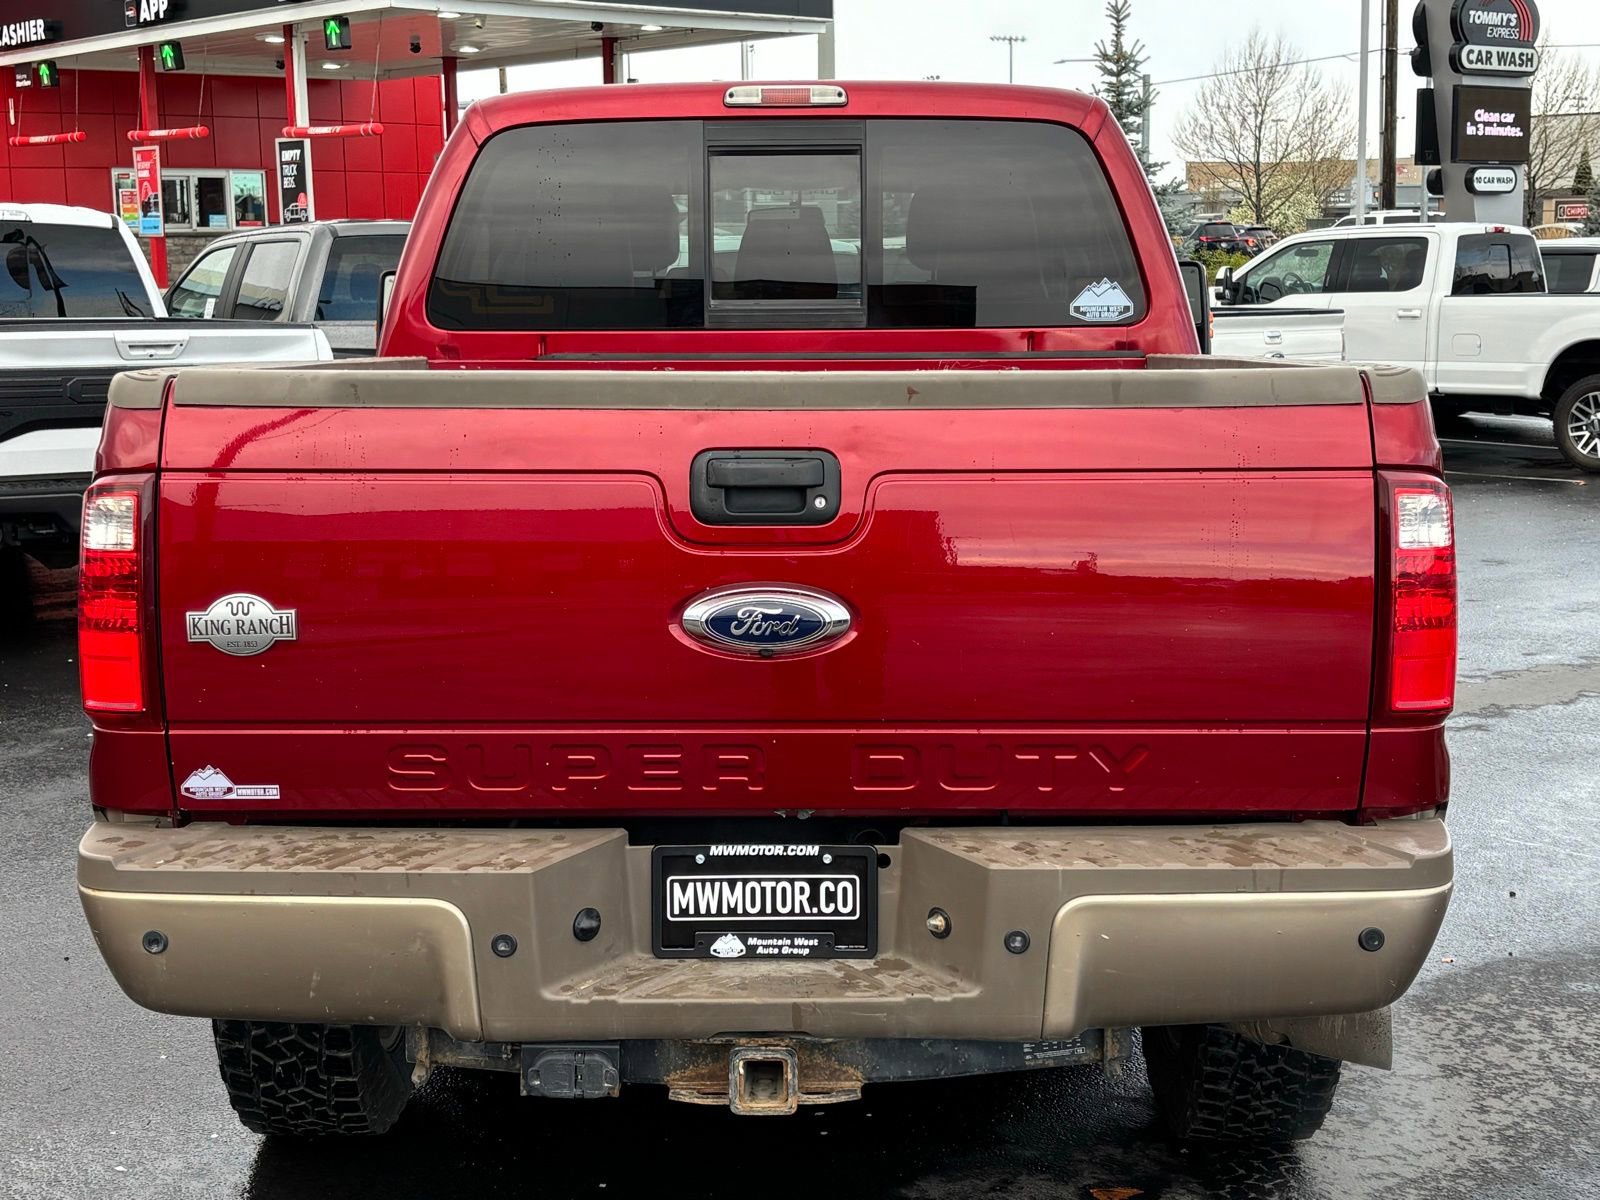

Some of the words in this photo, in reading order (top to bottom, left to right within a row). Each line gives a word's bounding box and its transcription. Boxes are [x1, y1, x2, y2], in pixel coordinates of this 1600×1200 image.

[139, 0, 168, 22] APP
[1469, 10, 1517, 26] TOMMY'S
[1487, 26, 1519, 39] EXPRESS
[1466, 49, 1493, 65] CAR
[1497, 50, 1534, 68] WASH
[1474, 109, 1500, 122] Clean
[1500, 113, 1516, 123] car
[1466, 122, 1476, 135] in
[1477, 123, 1484, 136] 3
[1484, 123, 1523, 137] minutes.
[281, 149, 301, 162] EMPTY
[282, 164, 298, 176] TRUCK
[1483, 176, 1495, 184] CAR
[1496, 176, 1514, 185] WASH
[191, 617, 231, 636] KING
[235, 615, 292, 635] RANCH
[730, 606, 801, 636] Ford
[386, 743, 767, 792] SUPER
[852, 743, 1151, 792] DUTY
[709, 845, 820, 856] MWMOTOR.COM
[672, 881, 853, 915] MWMOTOR.CO
[747, 937, 791, 946] Mountain
[794, 937, 819, 946] West
[756, 946, 779, 954] Auto
[781, 946, 810, 956] Group
